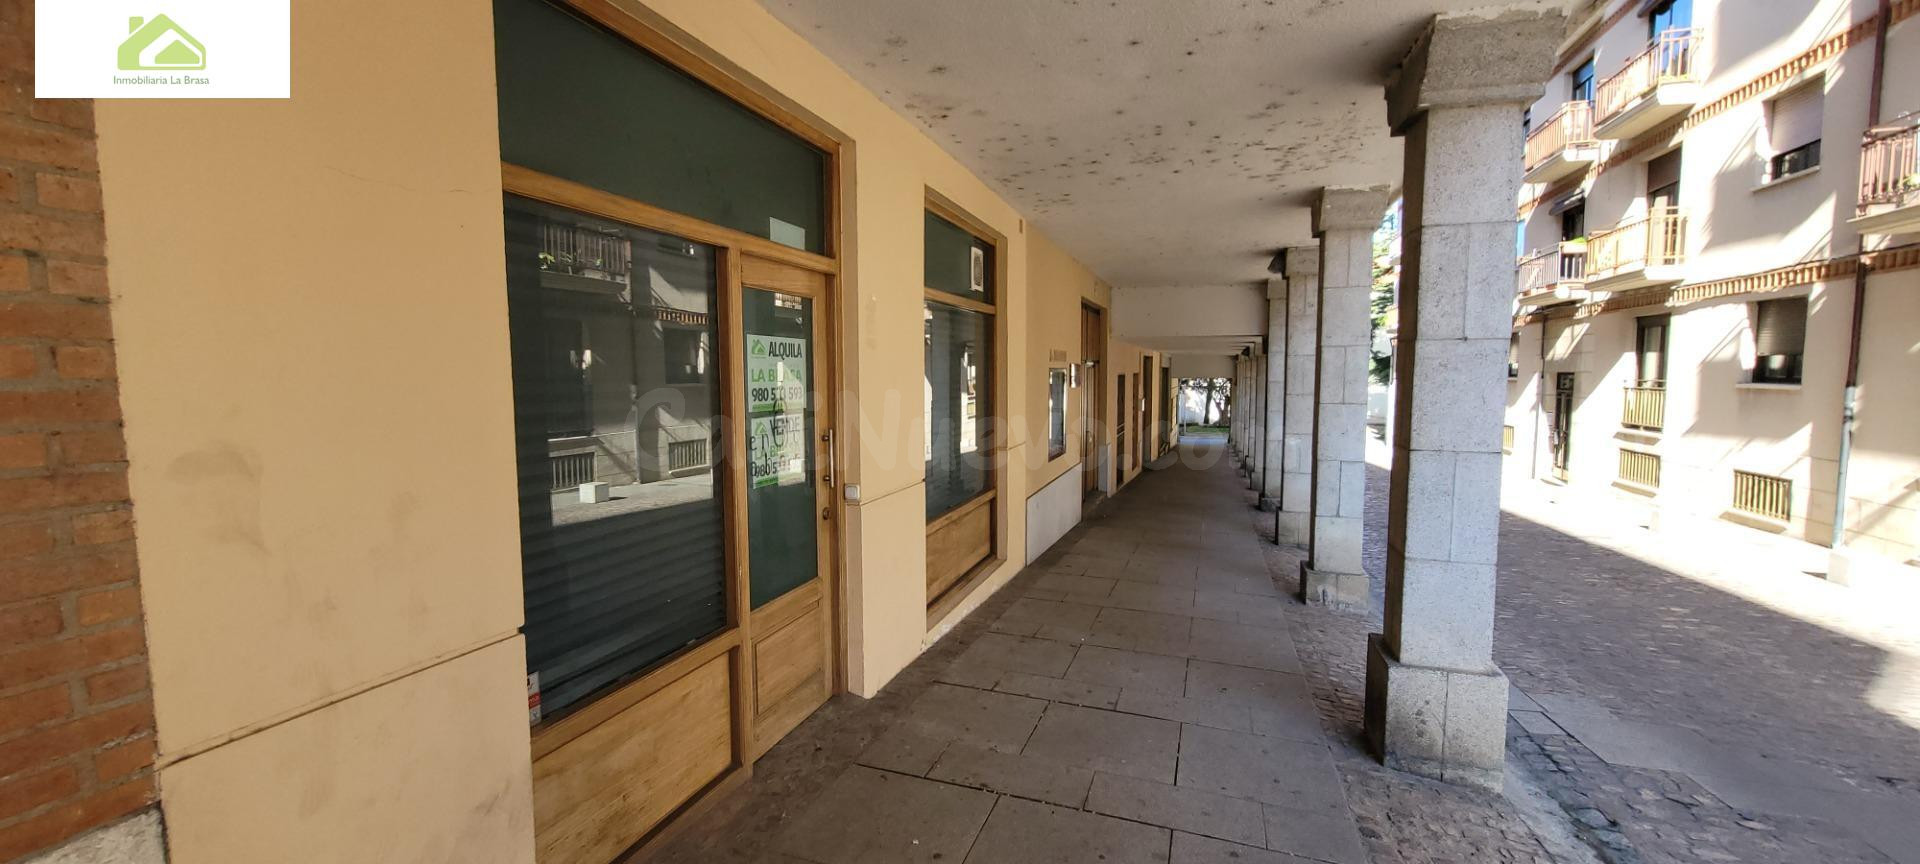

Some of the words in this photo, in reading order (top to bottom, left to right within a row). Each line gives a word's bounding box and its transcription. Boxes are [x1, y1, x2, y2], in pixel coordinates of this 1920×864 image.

[768, 341, 802, 360] ALQUILA
[751, 369, 766, 382] LA
[768, 368, 803, 383] BASA
[751, 388, 769, 401] 980
[770, 388, 786, 401] 53
